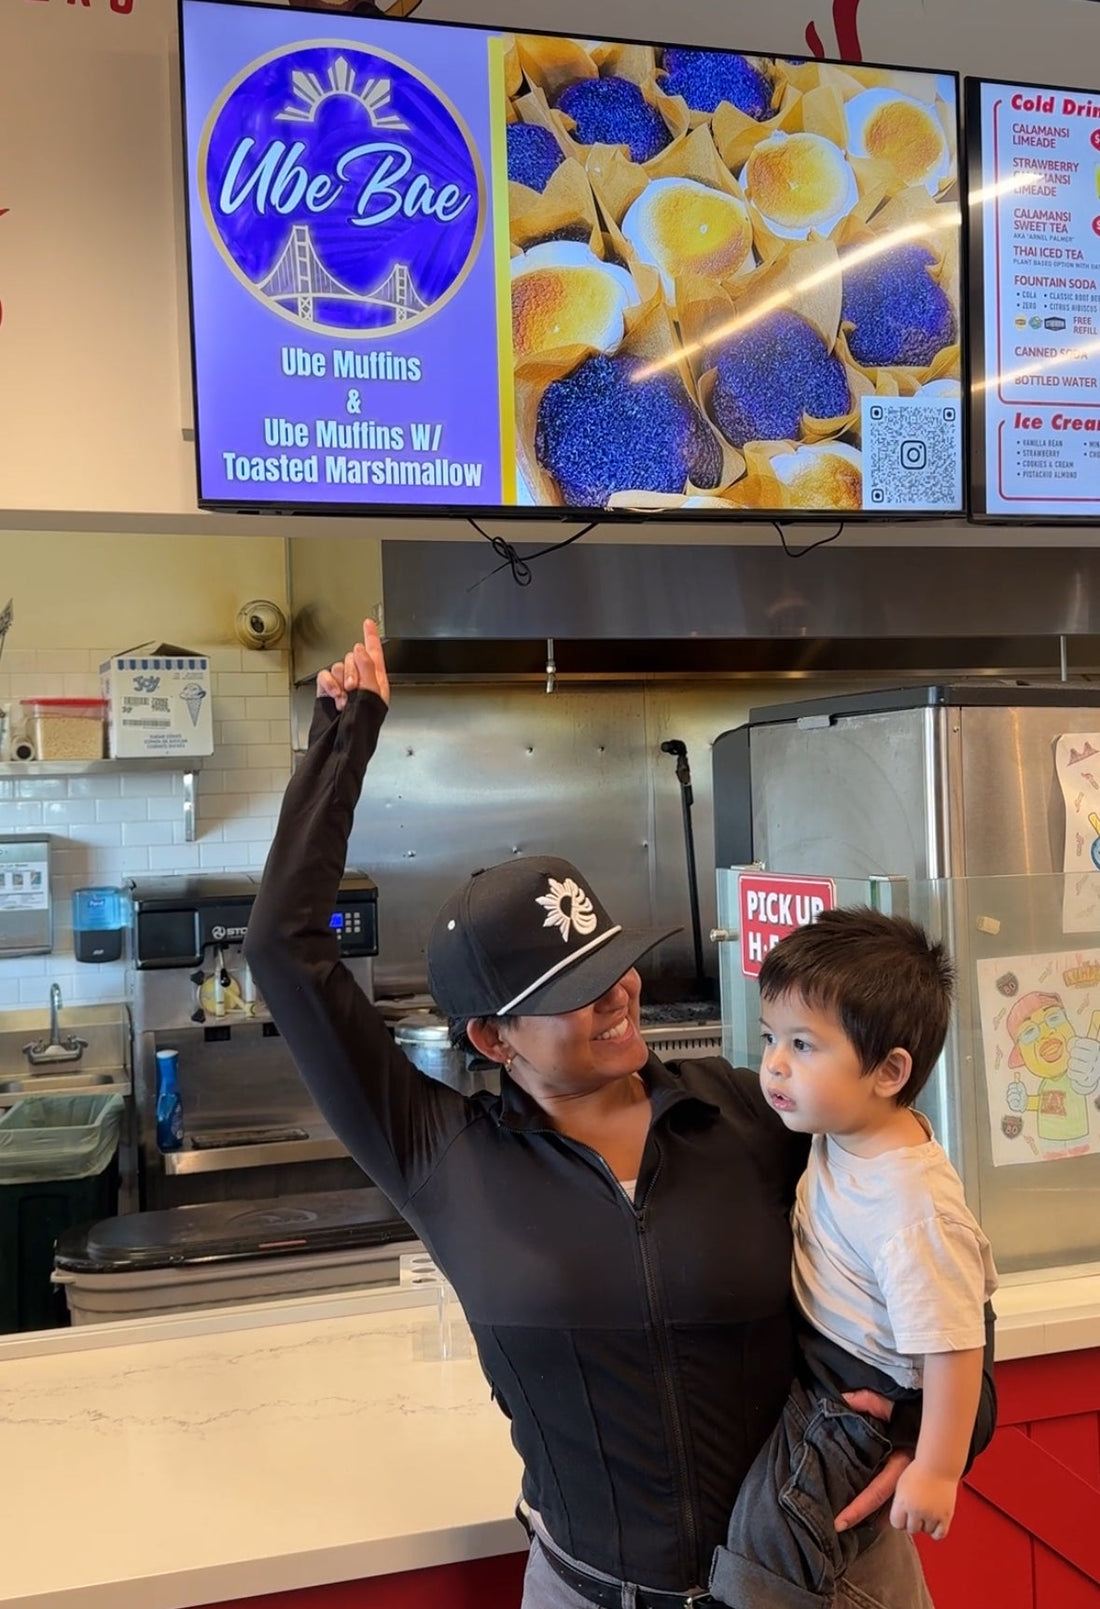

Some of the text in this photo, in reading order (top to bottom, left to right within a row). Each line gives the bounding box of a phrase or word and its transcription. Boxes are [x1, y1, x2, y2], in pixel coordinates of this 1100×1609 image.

[1011, 94, 1055, 113] Cold
[1012, 123, 1070, 138] CALAMANSI
[1012, 136, 1056, 149] LIMEADE
[1013, 157, 1079, 172] STRAWBERRY
[219, 137, 472, 226] Ube Bae
[1014, 208, 1071, 222] CALAMANSI
[1014, 220, 1068, 234] SWEET TEA
[1013, 245, 1084, 260] THAI ICED TEA
[1014, 275, 1096, 290] FOUNTAIN SODA
[1022, 291, 1036, 299] COLA
[1049, 292, 1073, 300] CLASSIC
[1075, 293, 1089, 301] ROOT
[1049, 303, 1069, 311] CITRUS
[1073, 316, 1092, 325] FREE
[1073, 326, 1098, 335] REFILL
[1015, 346, 1057, 358] CANNED
[281, 347, 422, 382] Ube Muffins
[1015, 375, 1097, 388] BOTTLED WATER
[347, 389, 361, 415] &
[1014, 412, 1043, 429] Ice
[264, 418, 442, 452] Ube Muffins W/
[1023, 439, 1046, 447] VANILLA
[223, 452, 483, 487] Toasted Marshmallow
[1022, 460, 1047, 468] COOKIES
[1054, 471, 1077, 479] ALMOND
[747, 890, 824, 926] PICK UP
